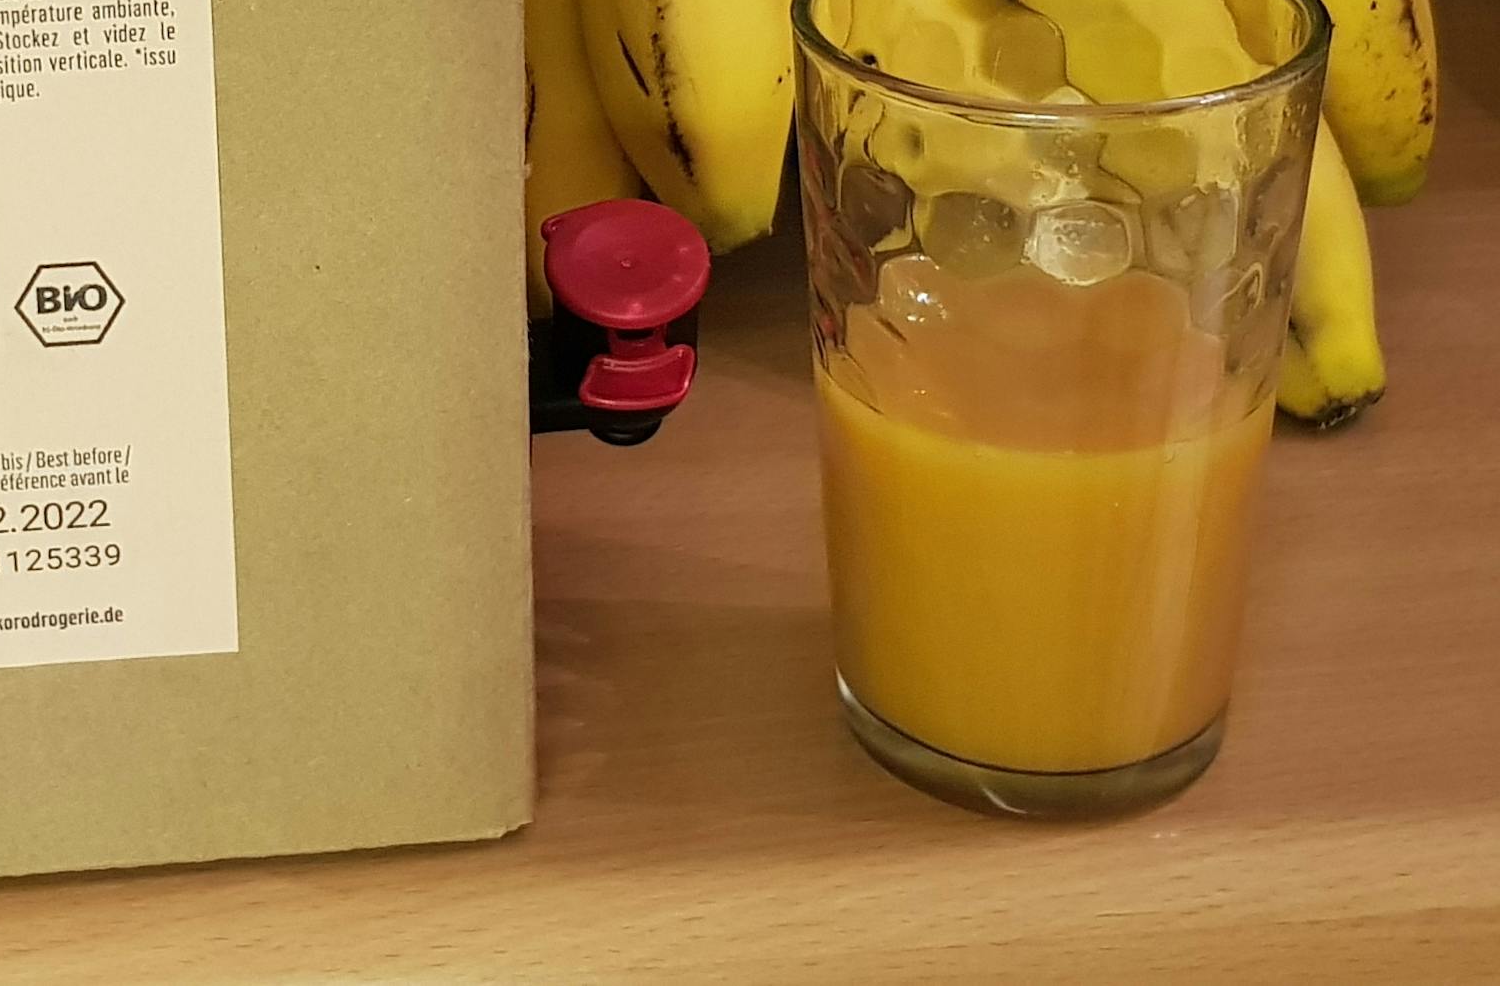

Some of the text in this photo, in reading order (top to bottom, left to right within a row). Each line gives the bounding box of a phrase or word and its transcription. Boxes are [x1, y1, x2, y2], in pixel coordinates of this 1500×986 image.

[1, 452, 23, 471] bis
[36, 451, 69, 469] Best
[70, 469, 112, 487] avant
